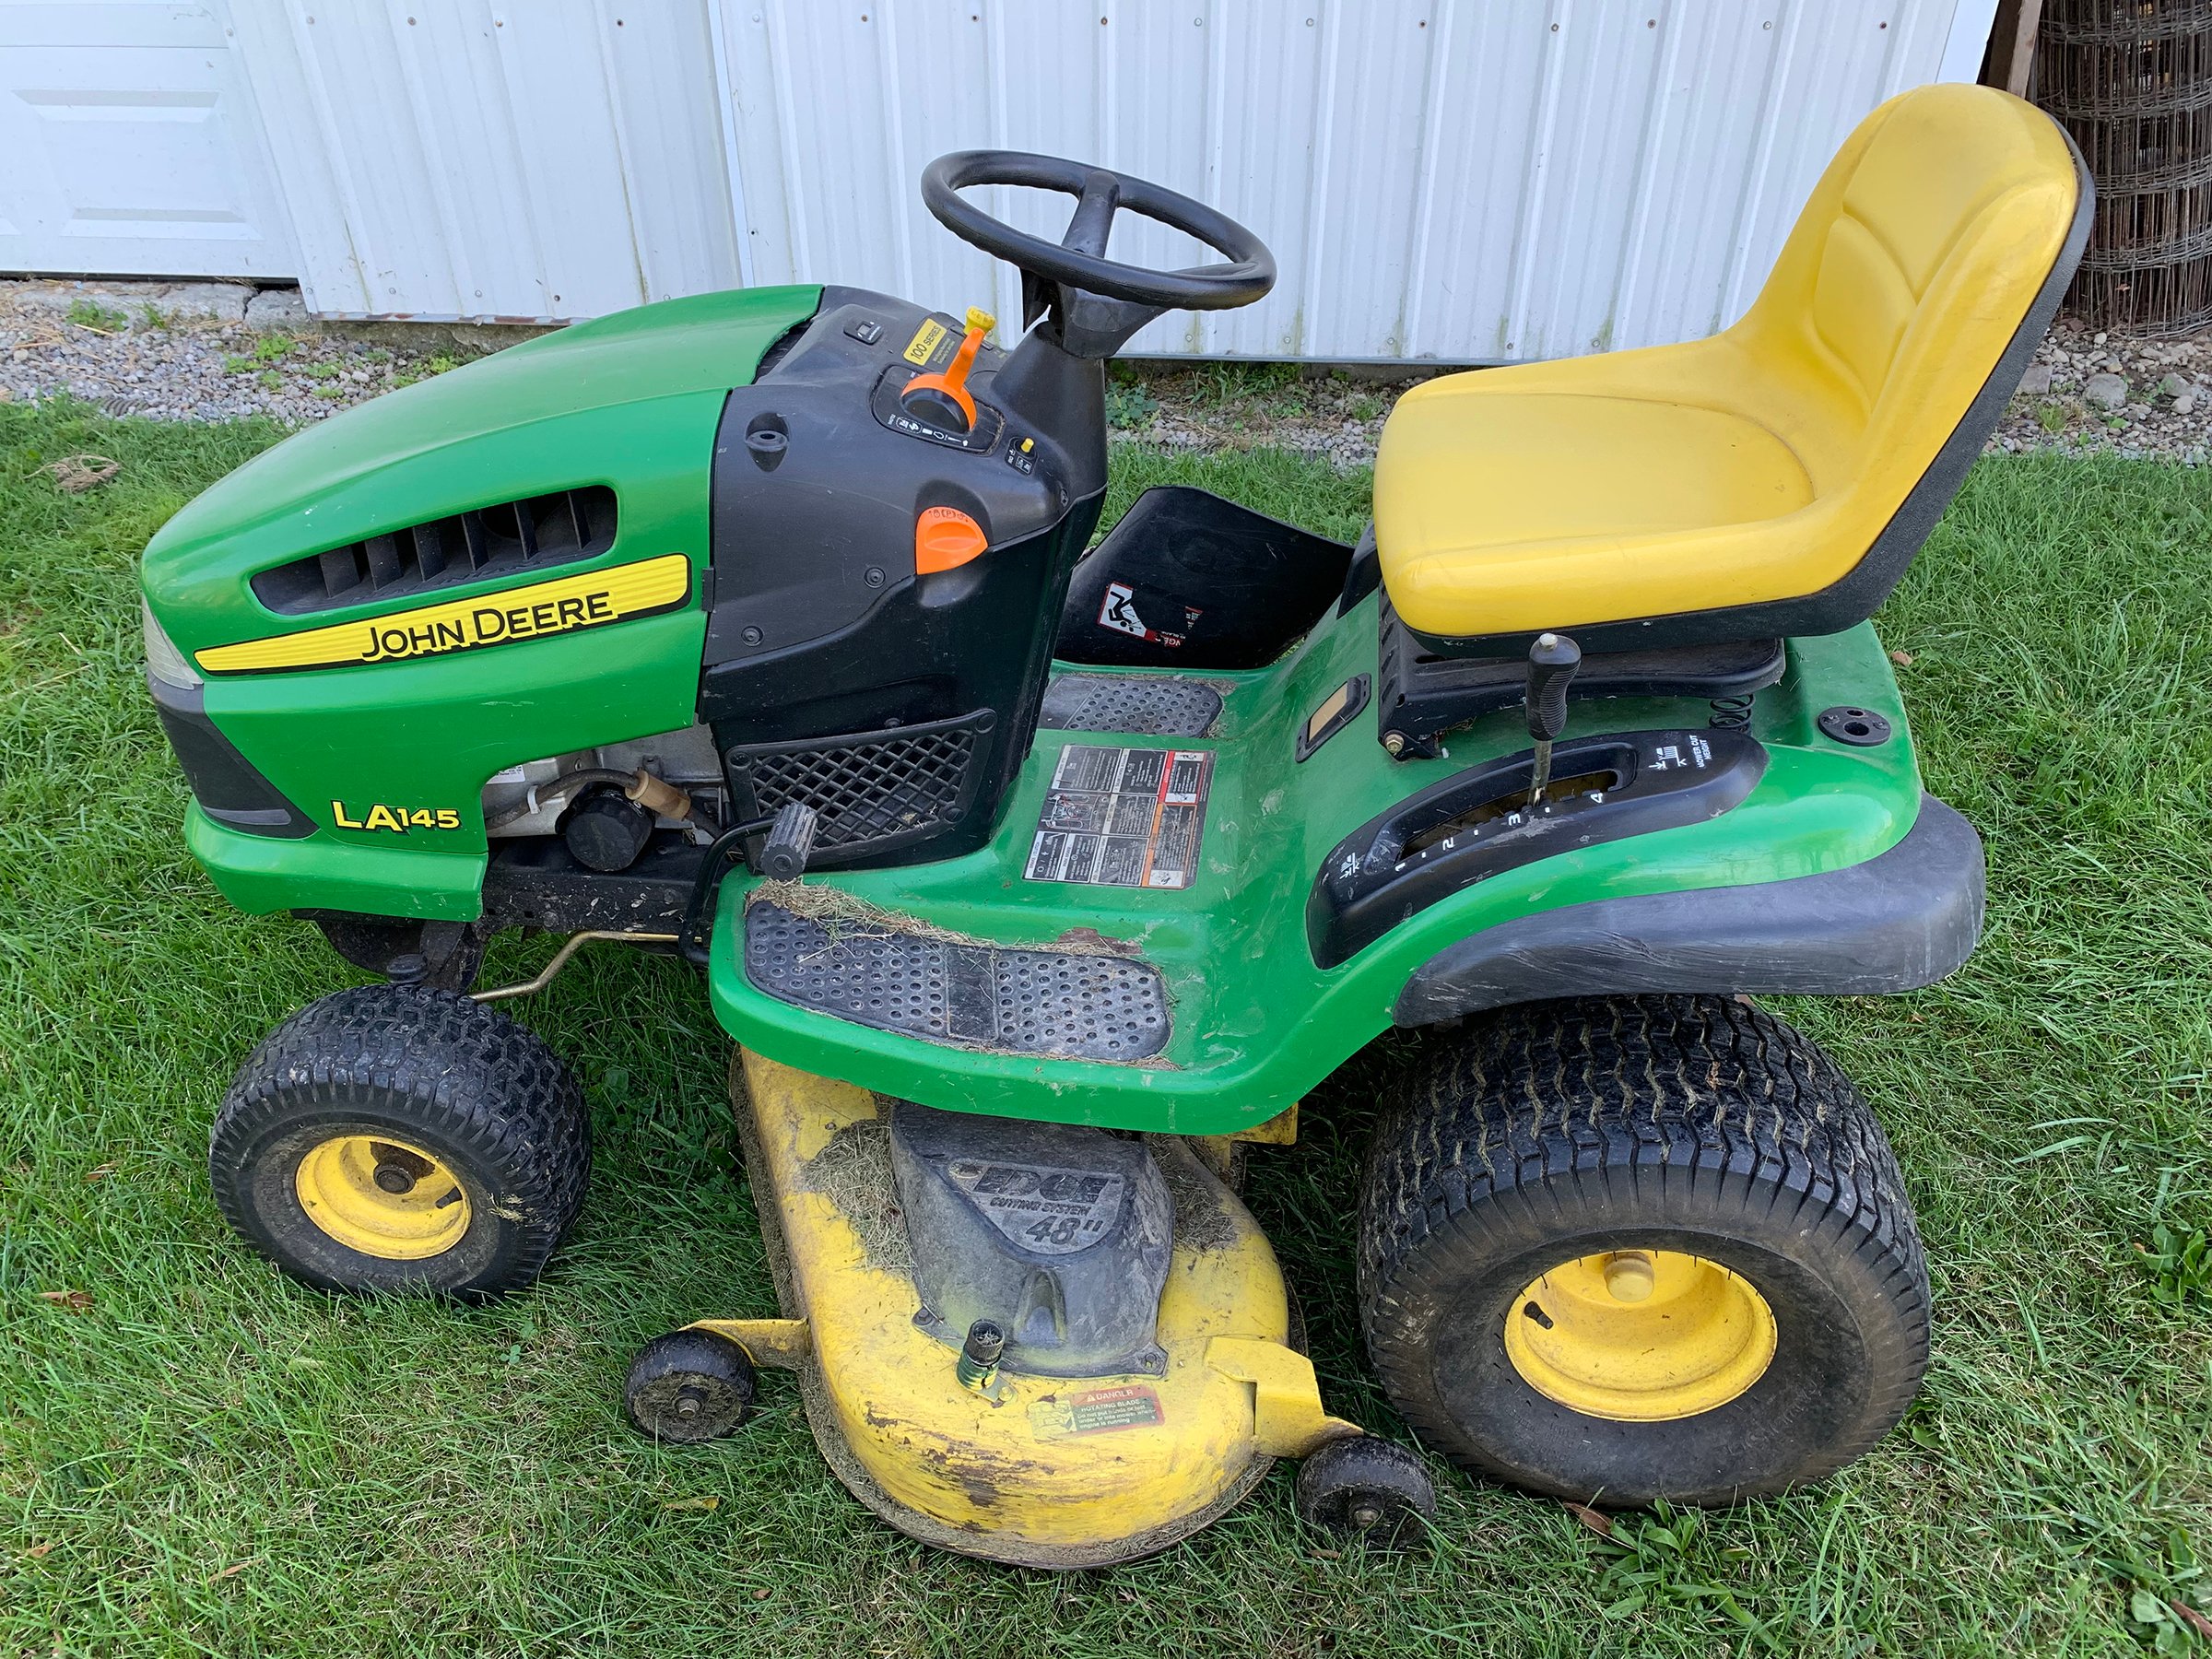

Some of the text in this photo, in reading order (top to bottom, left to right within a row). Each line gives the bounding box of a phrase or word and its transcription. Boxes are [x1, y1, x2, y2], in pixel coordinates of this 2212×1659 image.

[911, 343, 927, 359] 100
[924, 325, 941, 346] SERIES
[361, 592, 613, 659] JOHN DEERE
[1689, 735, 1705, 768] MOWER CUT
[1700, 739, 1712, 759] HEIGHT
[1590, 793, 1603, 804] 4
[331, 800, 462, 832] LA145
[1508, 813, 1521, 826] 3
[1442, 837, 1454, 851] 2
[1395, 862, 1406, 871] 1
[973, 1167, 1109, 1204] EDGE
[990, 1196, 1091, 1217] CUTTING SYSTEM
